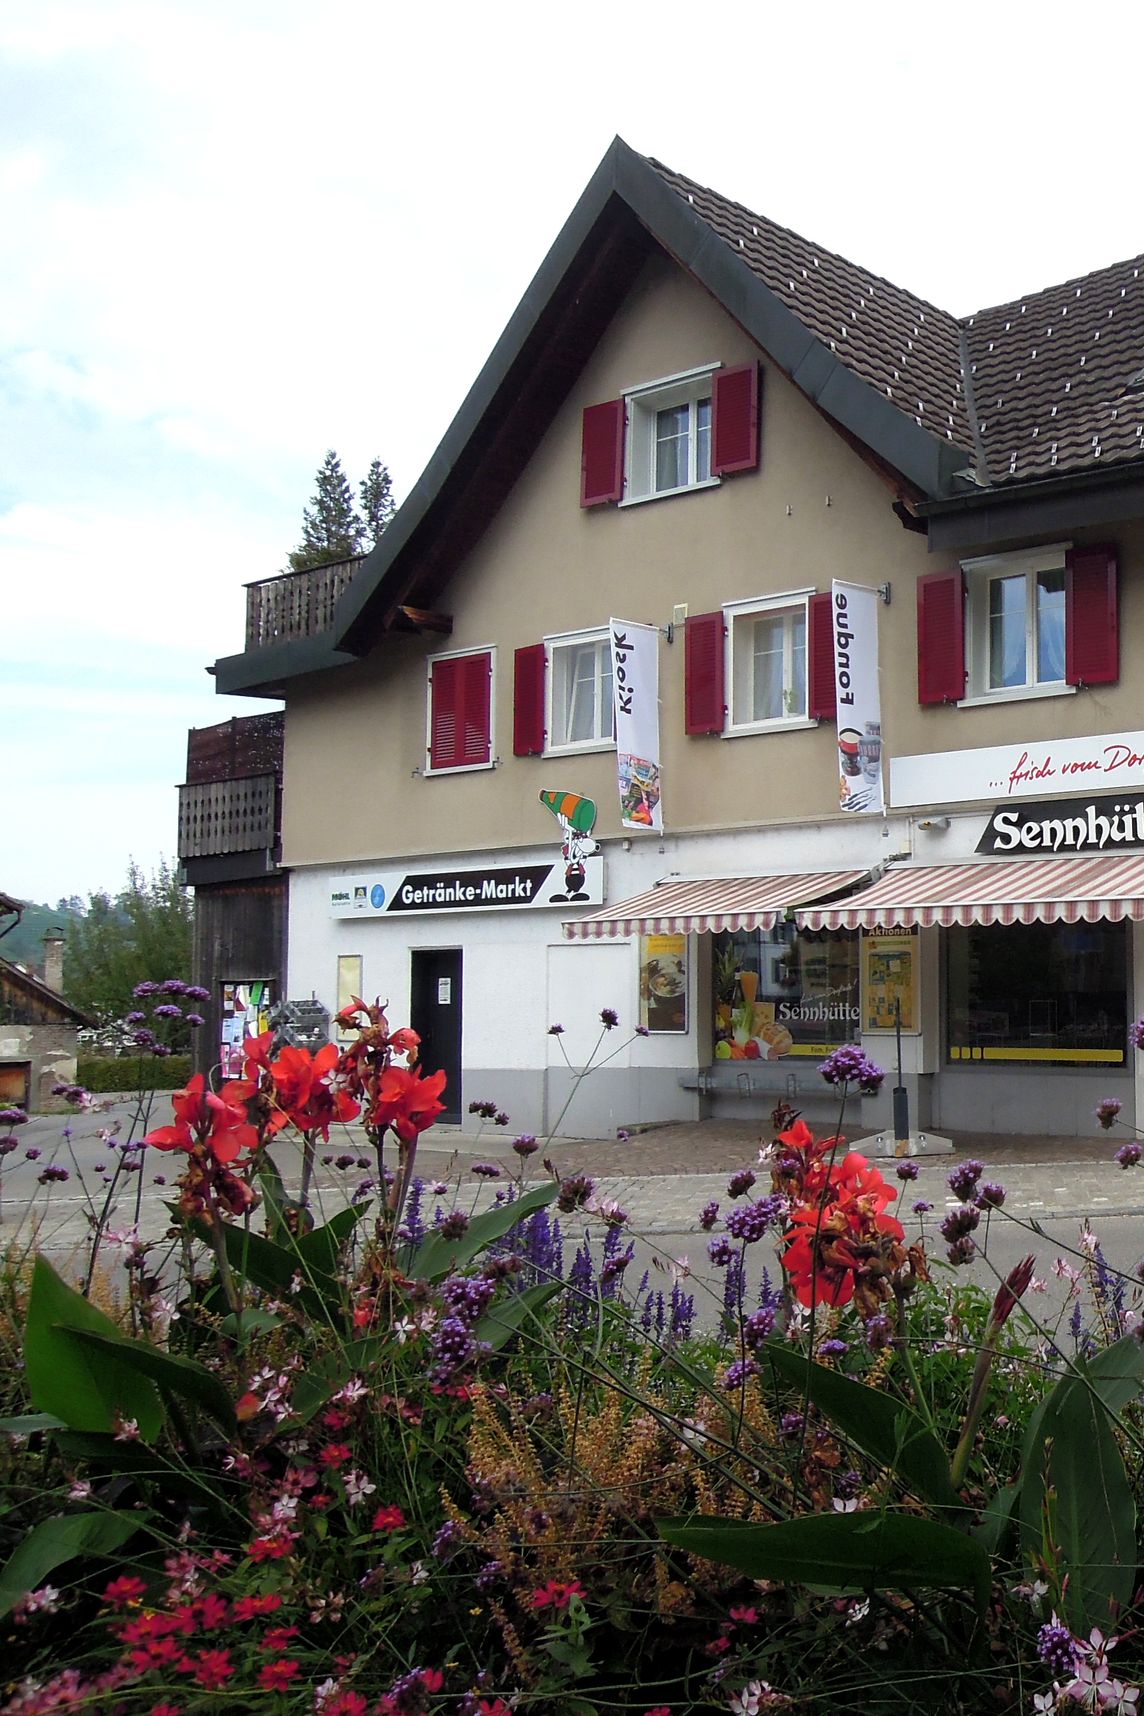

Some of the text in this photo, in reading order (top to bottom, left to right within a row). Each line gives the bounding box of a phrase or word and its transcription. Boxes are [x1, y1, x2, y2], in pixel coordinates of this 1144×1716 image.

[1062, 760, 1102, 776] vom
[402, 876, 533, 904] Getränke-Markt
[779, 1002, 860, 1021] Sennhütte
